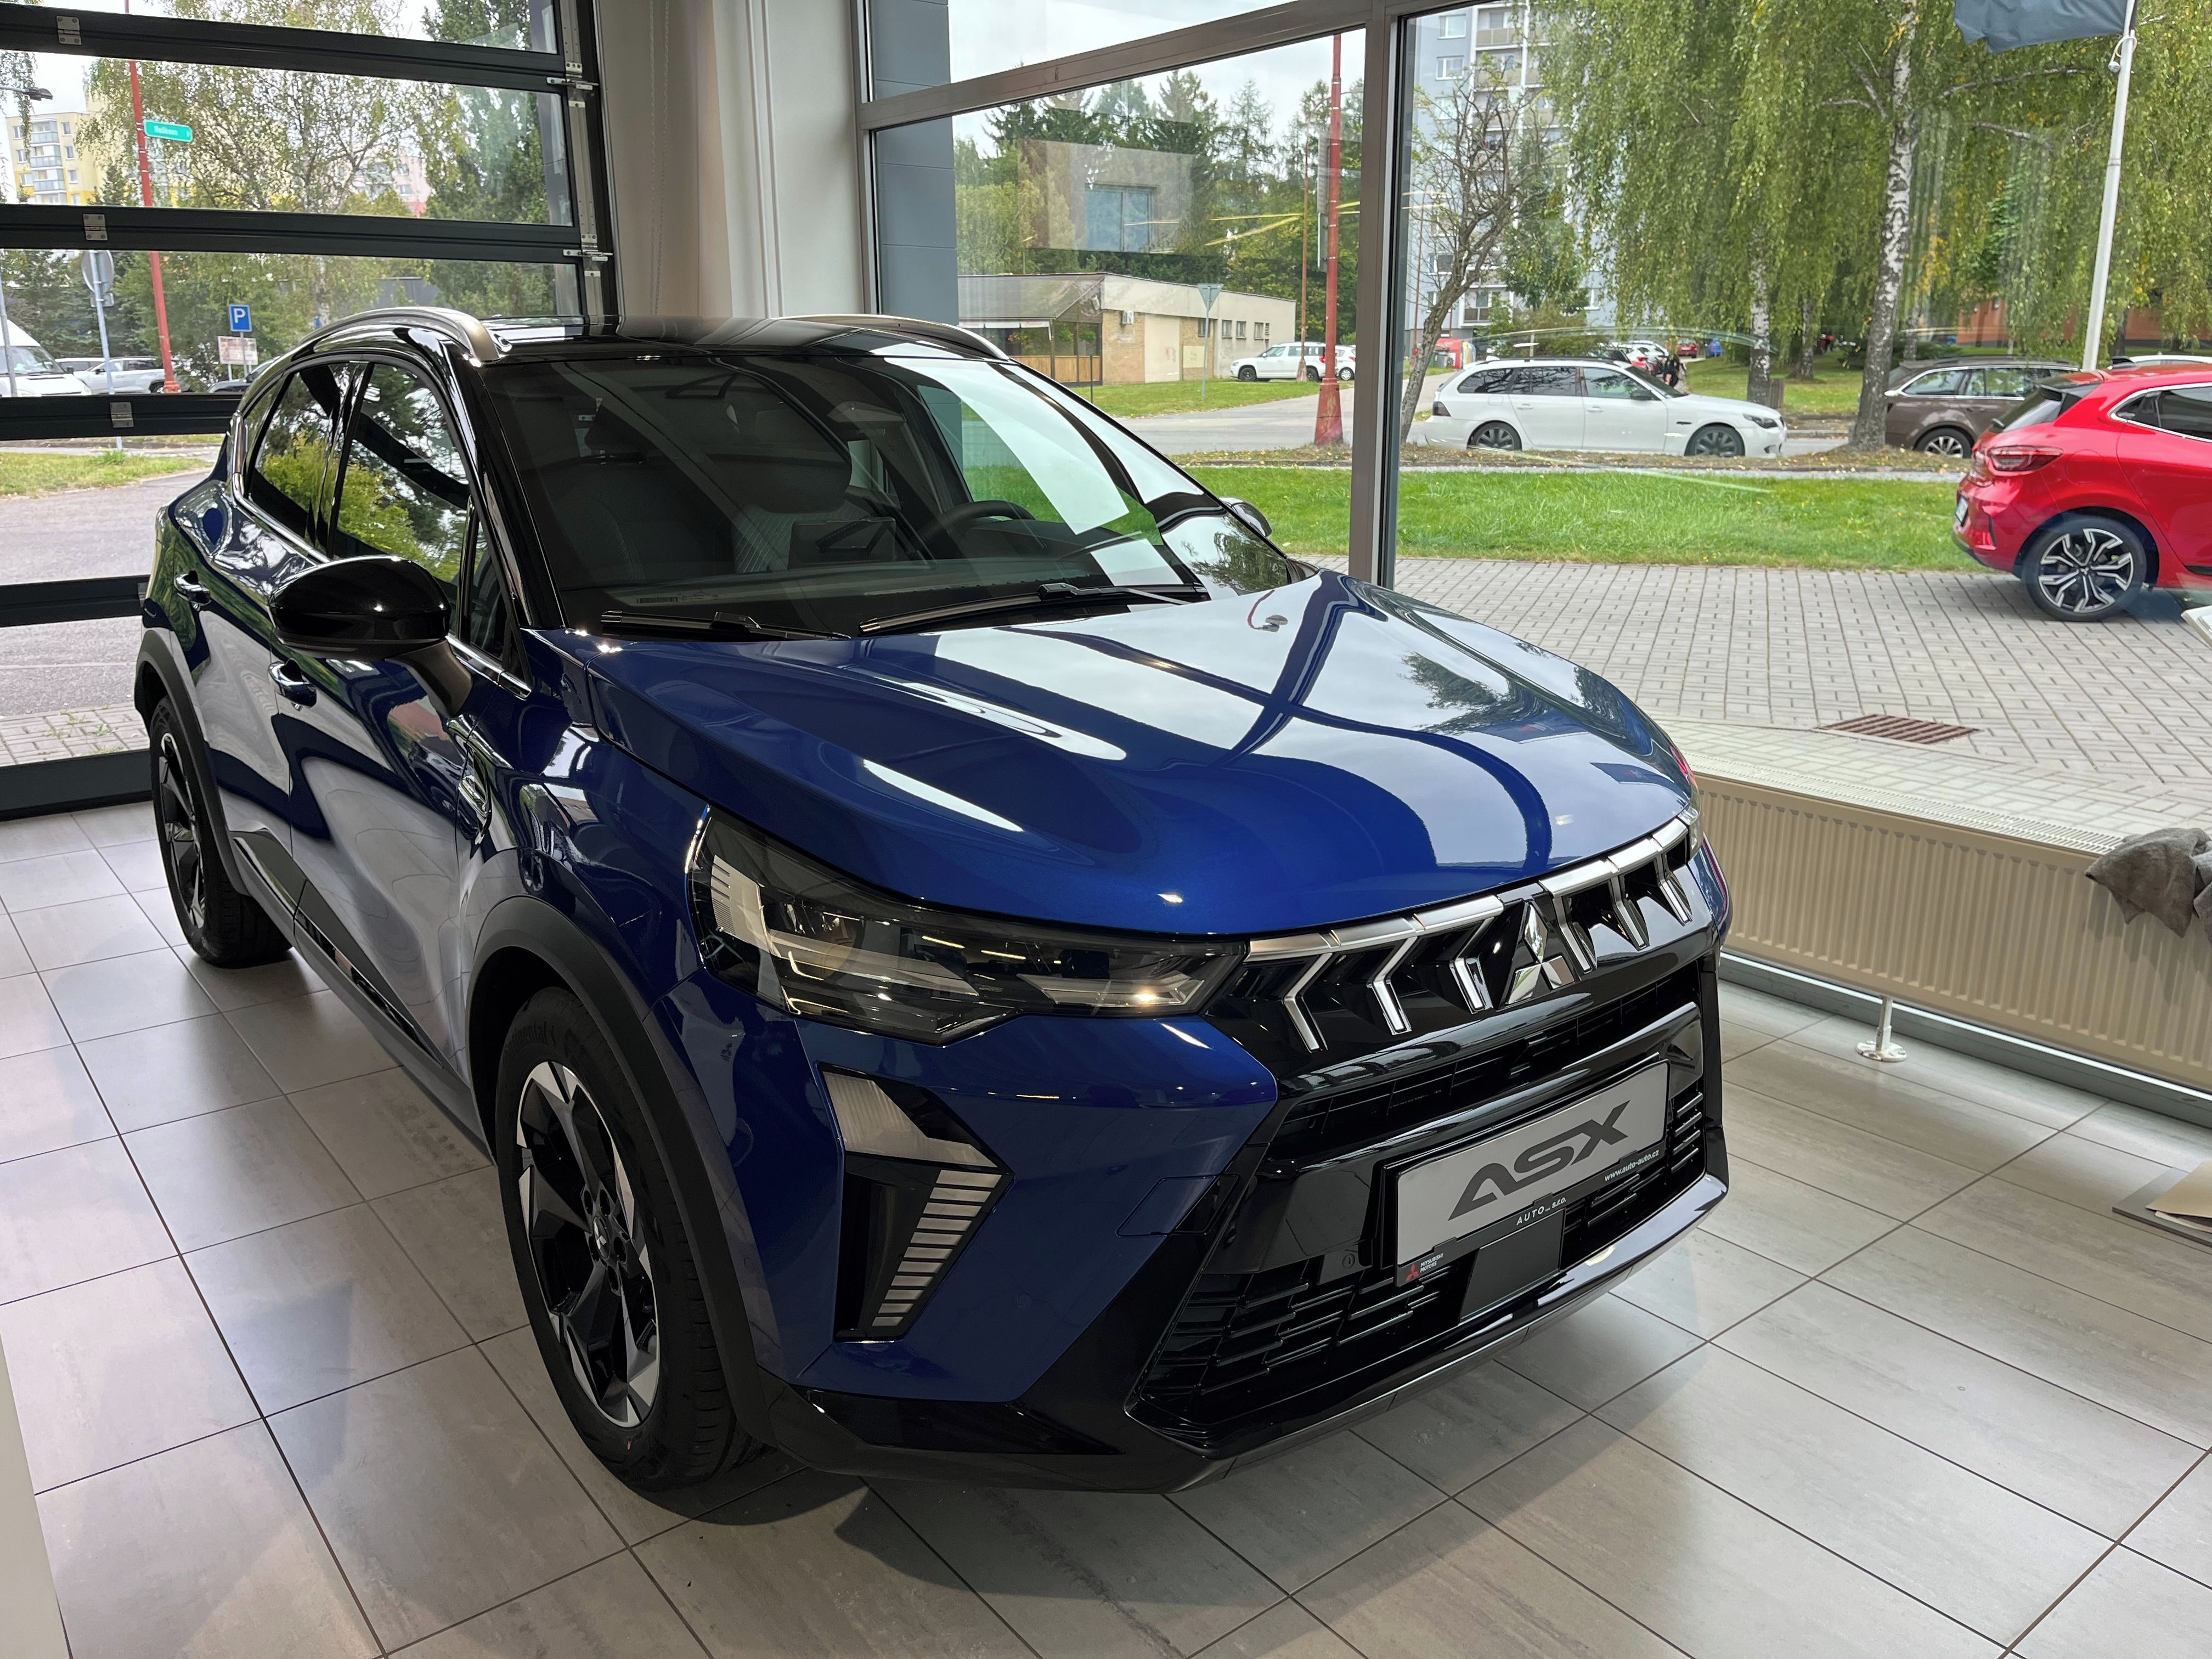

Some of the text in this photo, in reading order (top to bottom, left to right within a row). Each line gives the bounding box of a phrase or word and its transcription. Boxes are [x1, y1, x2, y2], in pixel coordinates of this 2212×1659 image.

[234, 308, 246, 323] P
[1448, 1100, 1630, 1221] ASX
[1605, 1149, 1660, 1182] www.auto-auto.cz
[1516, 1197, 1567, 1226] AUTO s.r.o.
[1420, 1253, 1443, 1267] MITSUBISHI
[1420, 1261, 1437, 1273] MOTORS
